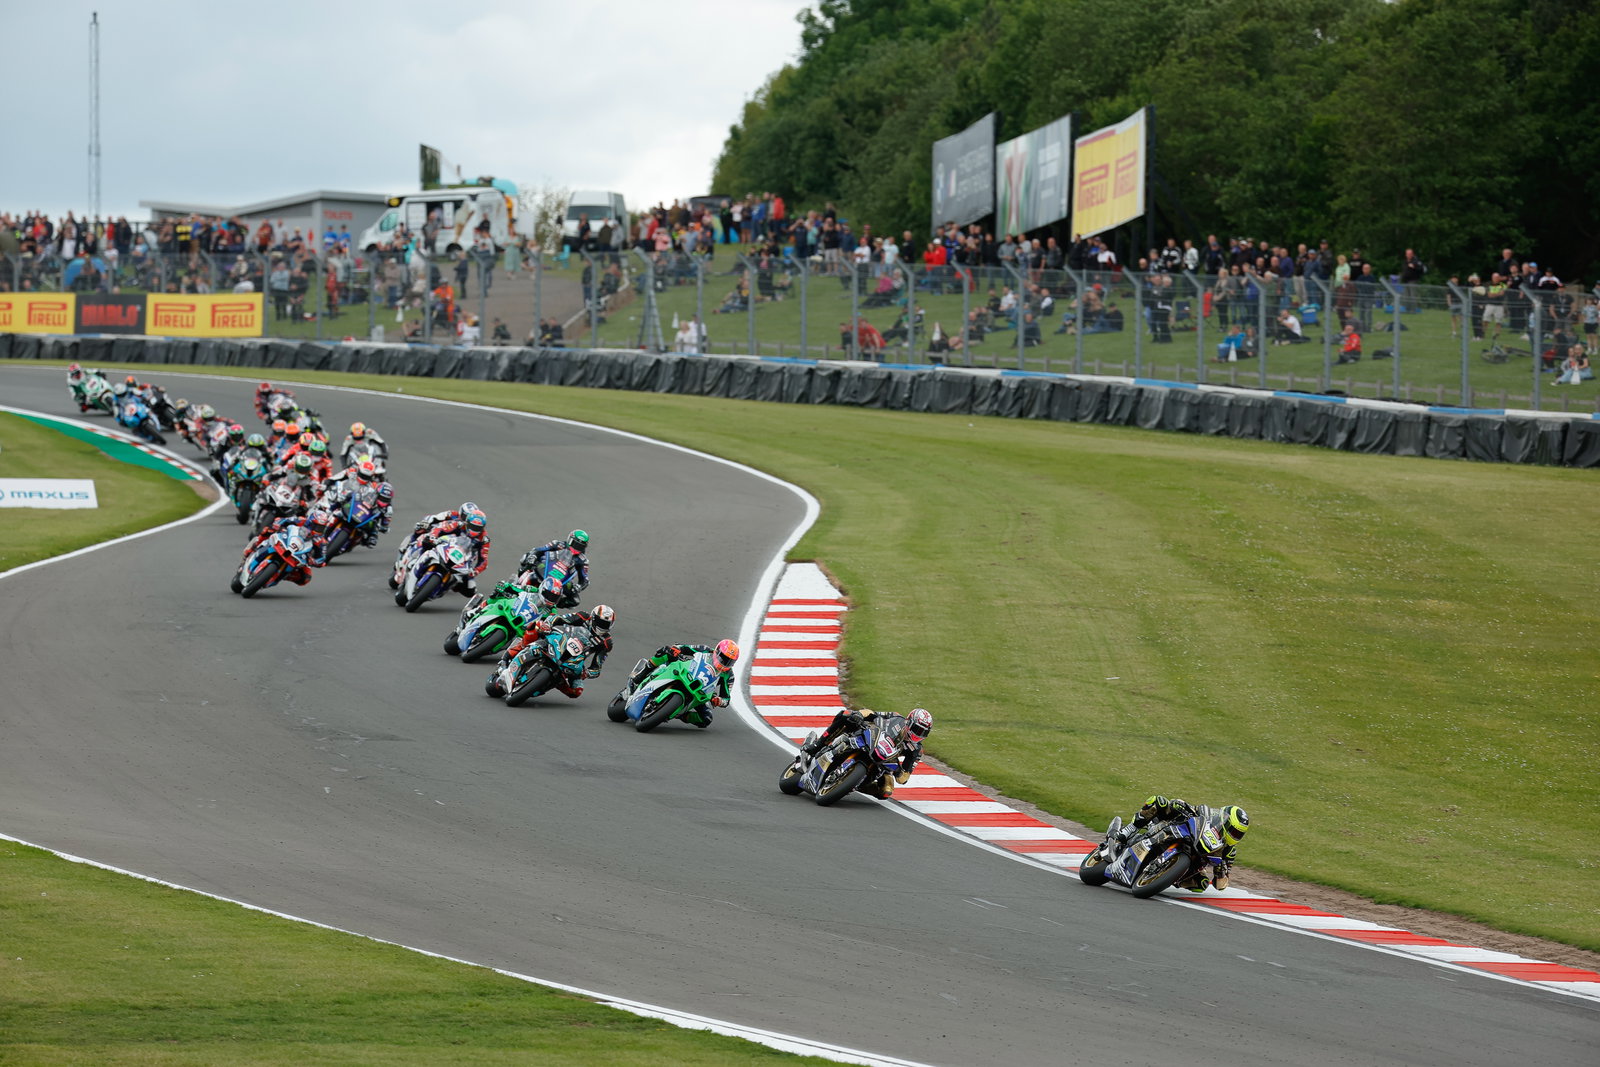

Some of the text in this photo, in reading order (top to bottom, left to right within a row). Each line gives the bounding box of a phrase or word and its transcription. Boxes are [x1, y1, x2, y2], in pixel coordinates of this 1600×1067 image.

[1077, 164, 1109, 212] PIRELLI
[28, 302, 67, 326] PIRELLI
[81, 304, 138, 326] DIABLO
[153, 303, 255, 328] PIRELLI PIRELLI
[10, 490, 89, 500] MAXUS
[568, 642, 580, 654] 60
